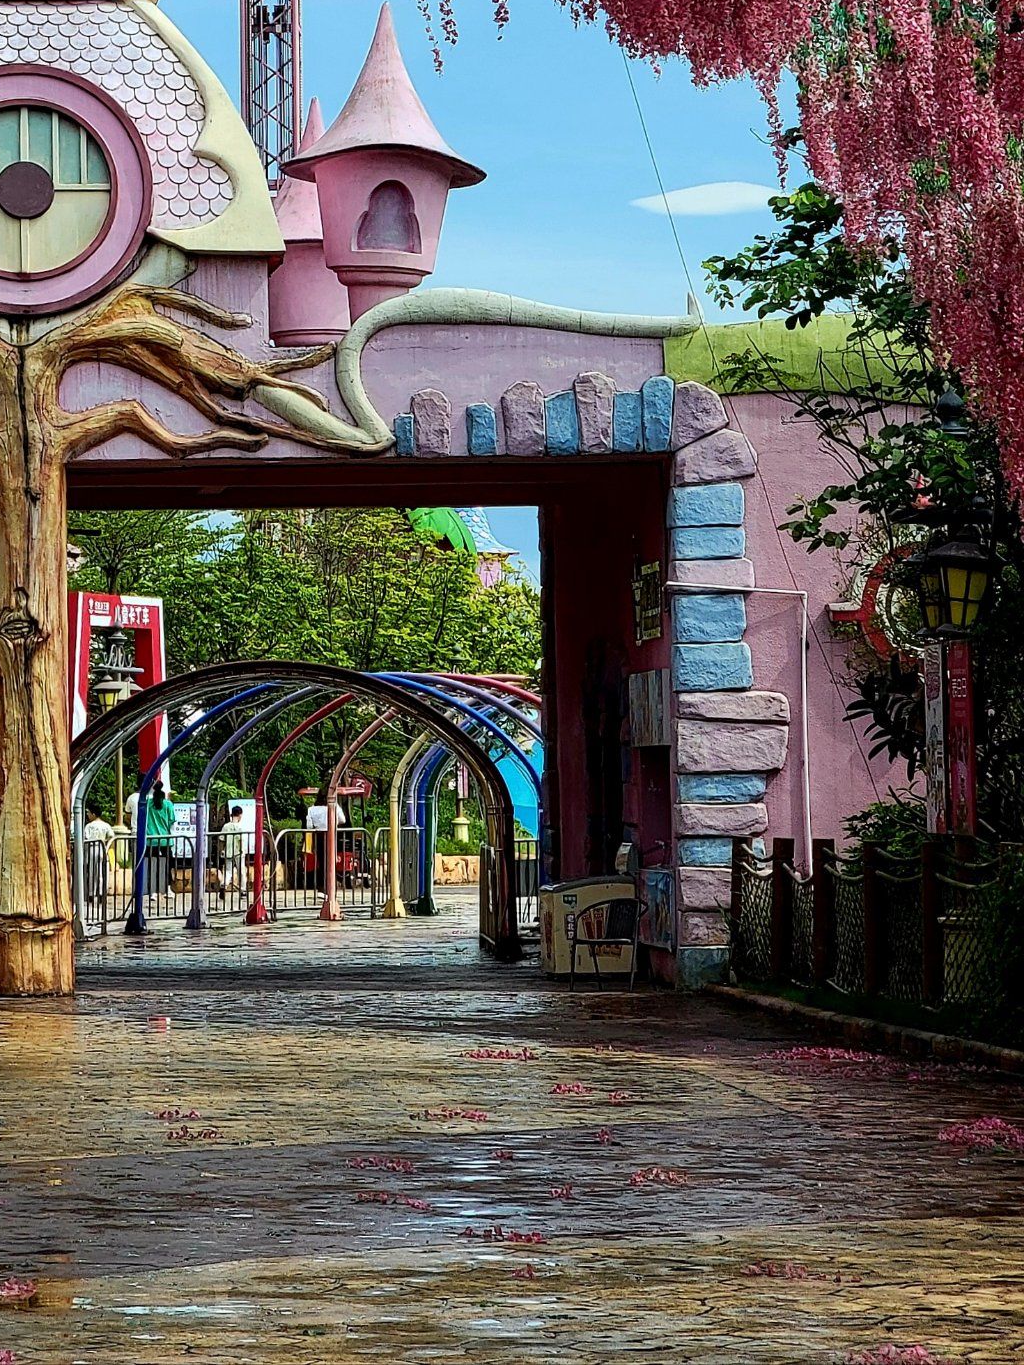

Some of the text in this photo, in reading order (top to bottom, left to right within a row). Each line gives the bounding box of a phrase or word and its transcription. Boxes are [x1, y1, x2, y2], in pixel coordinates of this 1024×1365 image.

[114, 604, 150, 625] 儿童卡丁车
